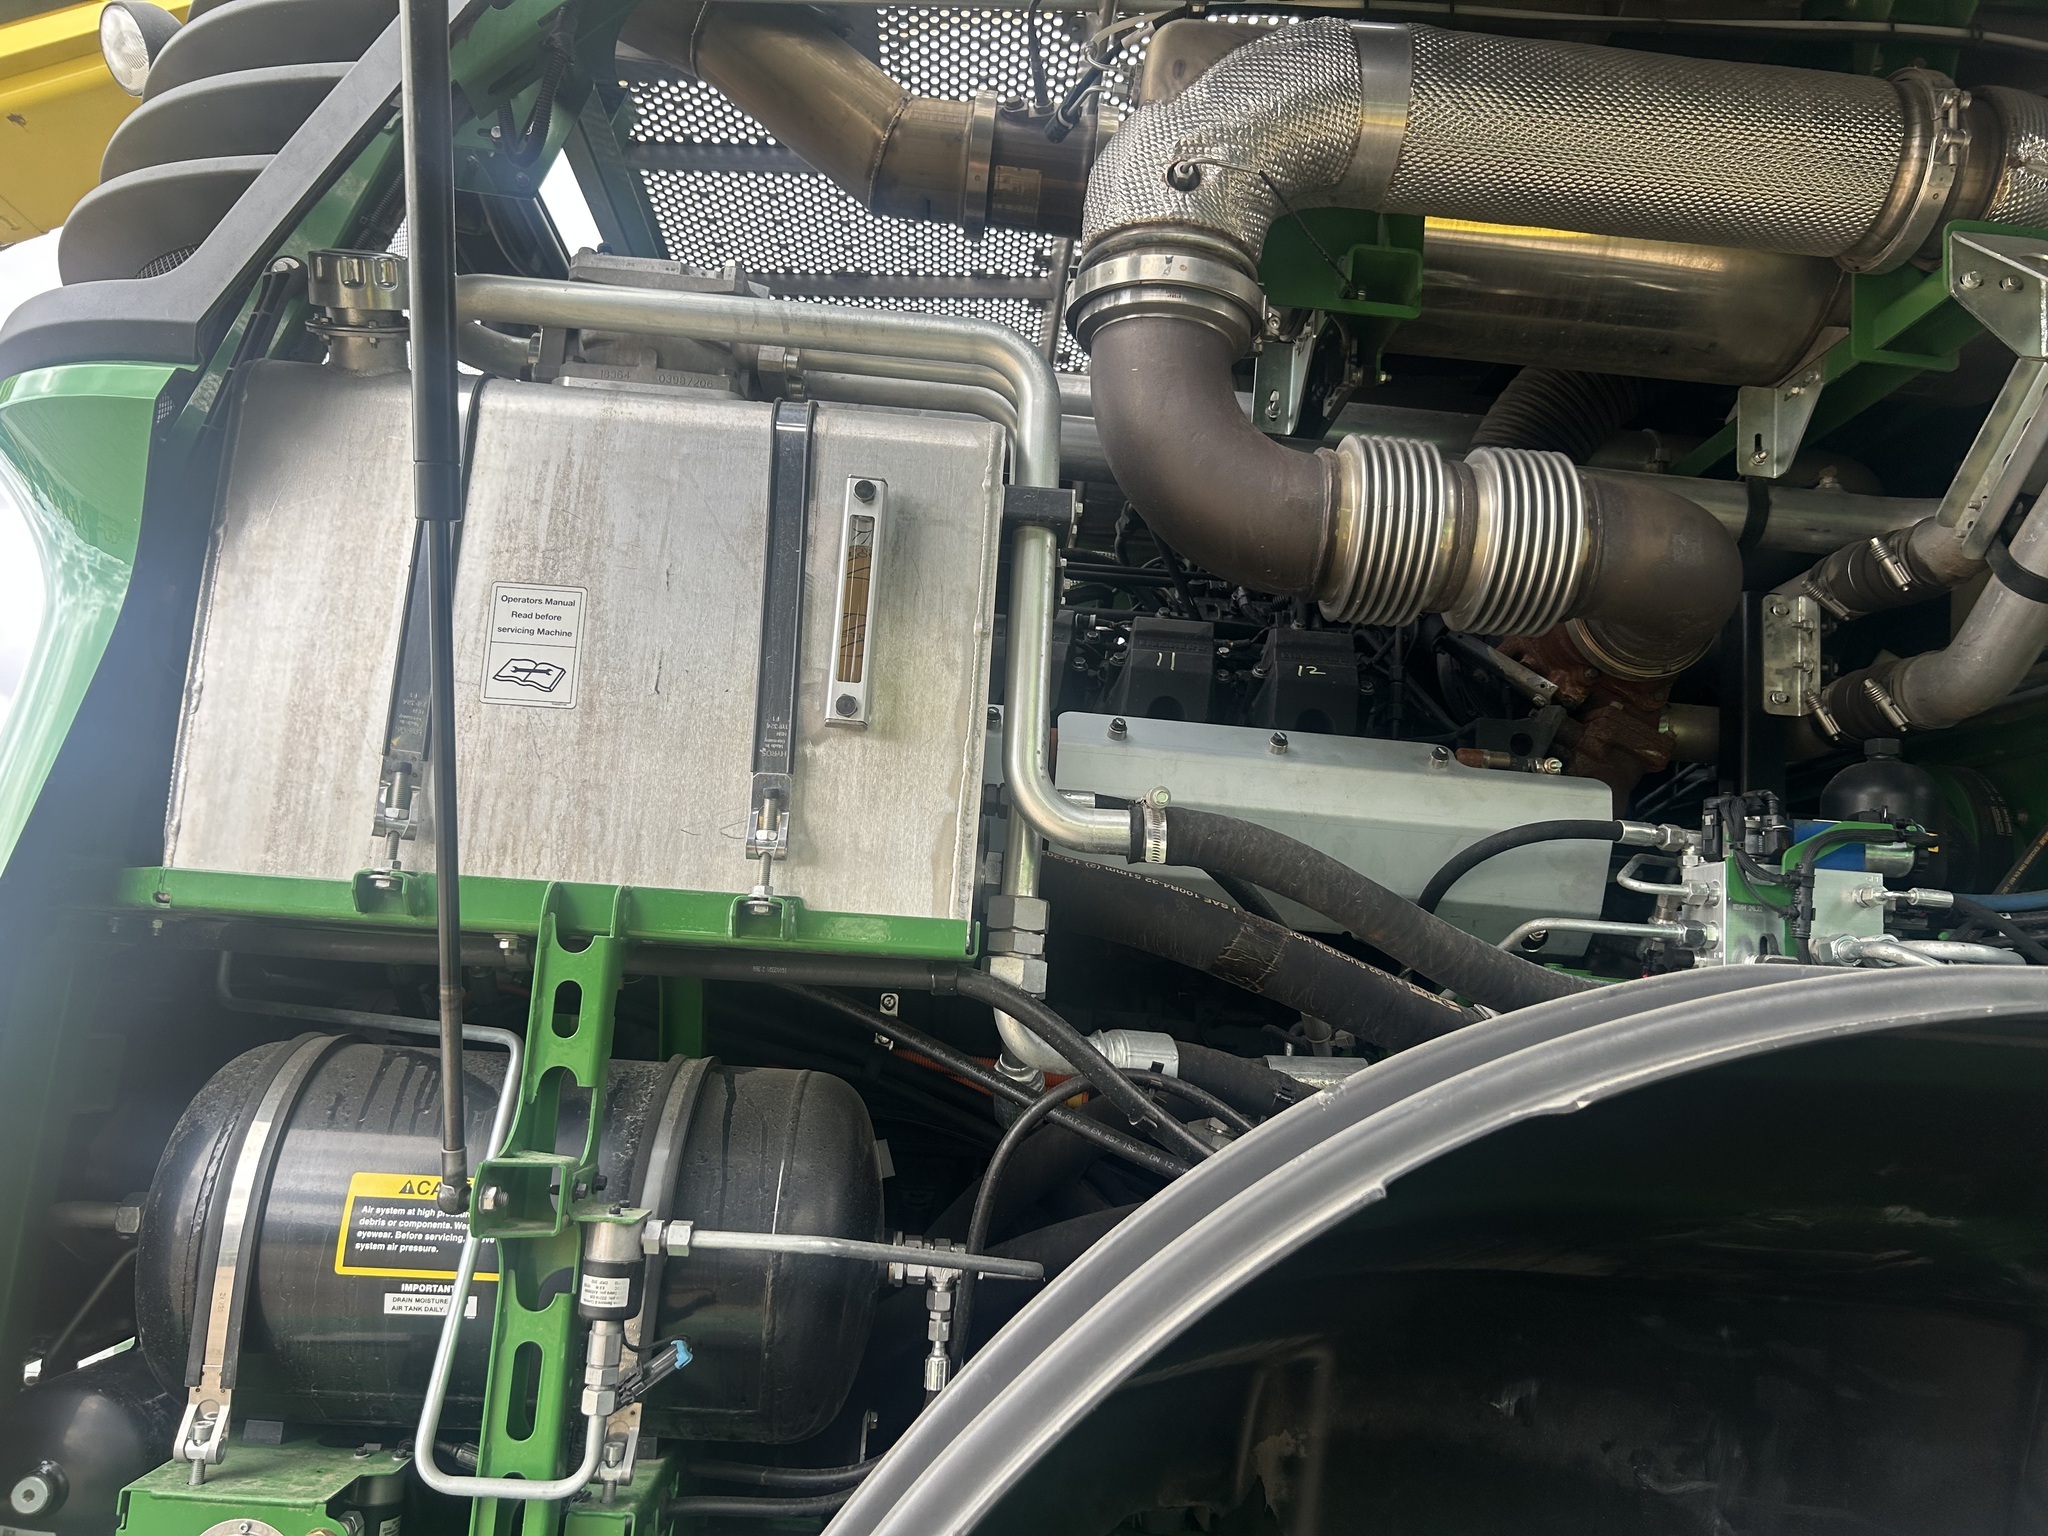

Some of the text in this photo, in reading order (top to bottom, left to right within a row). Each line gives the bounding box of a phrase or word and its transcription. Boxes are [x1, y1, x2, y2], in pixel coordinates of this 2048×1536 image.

[501, 594, 576, 607] Operators Manual
[511, 611, 562, 621] Read before
[497, 626, 572, 637] servicing Machine
[1298, 665, 1326, 677] 12
[1105, 866, 1142, 880] 51mm
[1203, 898, 1229, 910] SAE
[1315, 940, 1366, 969] SUCTION
[361, 1205, 375, 1214] Air
[375, 1207, 405, 1216] system
[407, 1208, 415, 1216] at
[417, 1208, 435, 1219] high
[359, 1218, 386, 1227] debris
[399, 1220, 453, 1230] components.
[356, 1231, 394, 1240] eyewear.
[395, 1231, 423, 1240] Before
[354, 1243, 439, 1253] system air pressure.
[415, 1297, 449, 1305] MOISTURE
